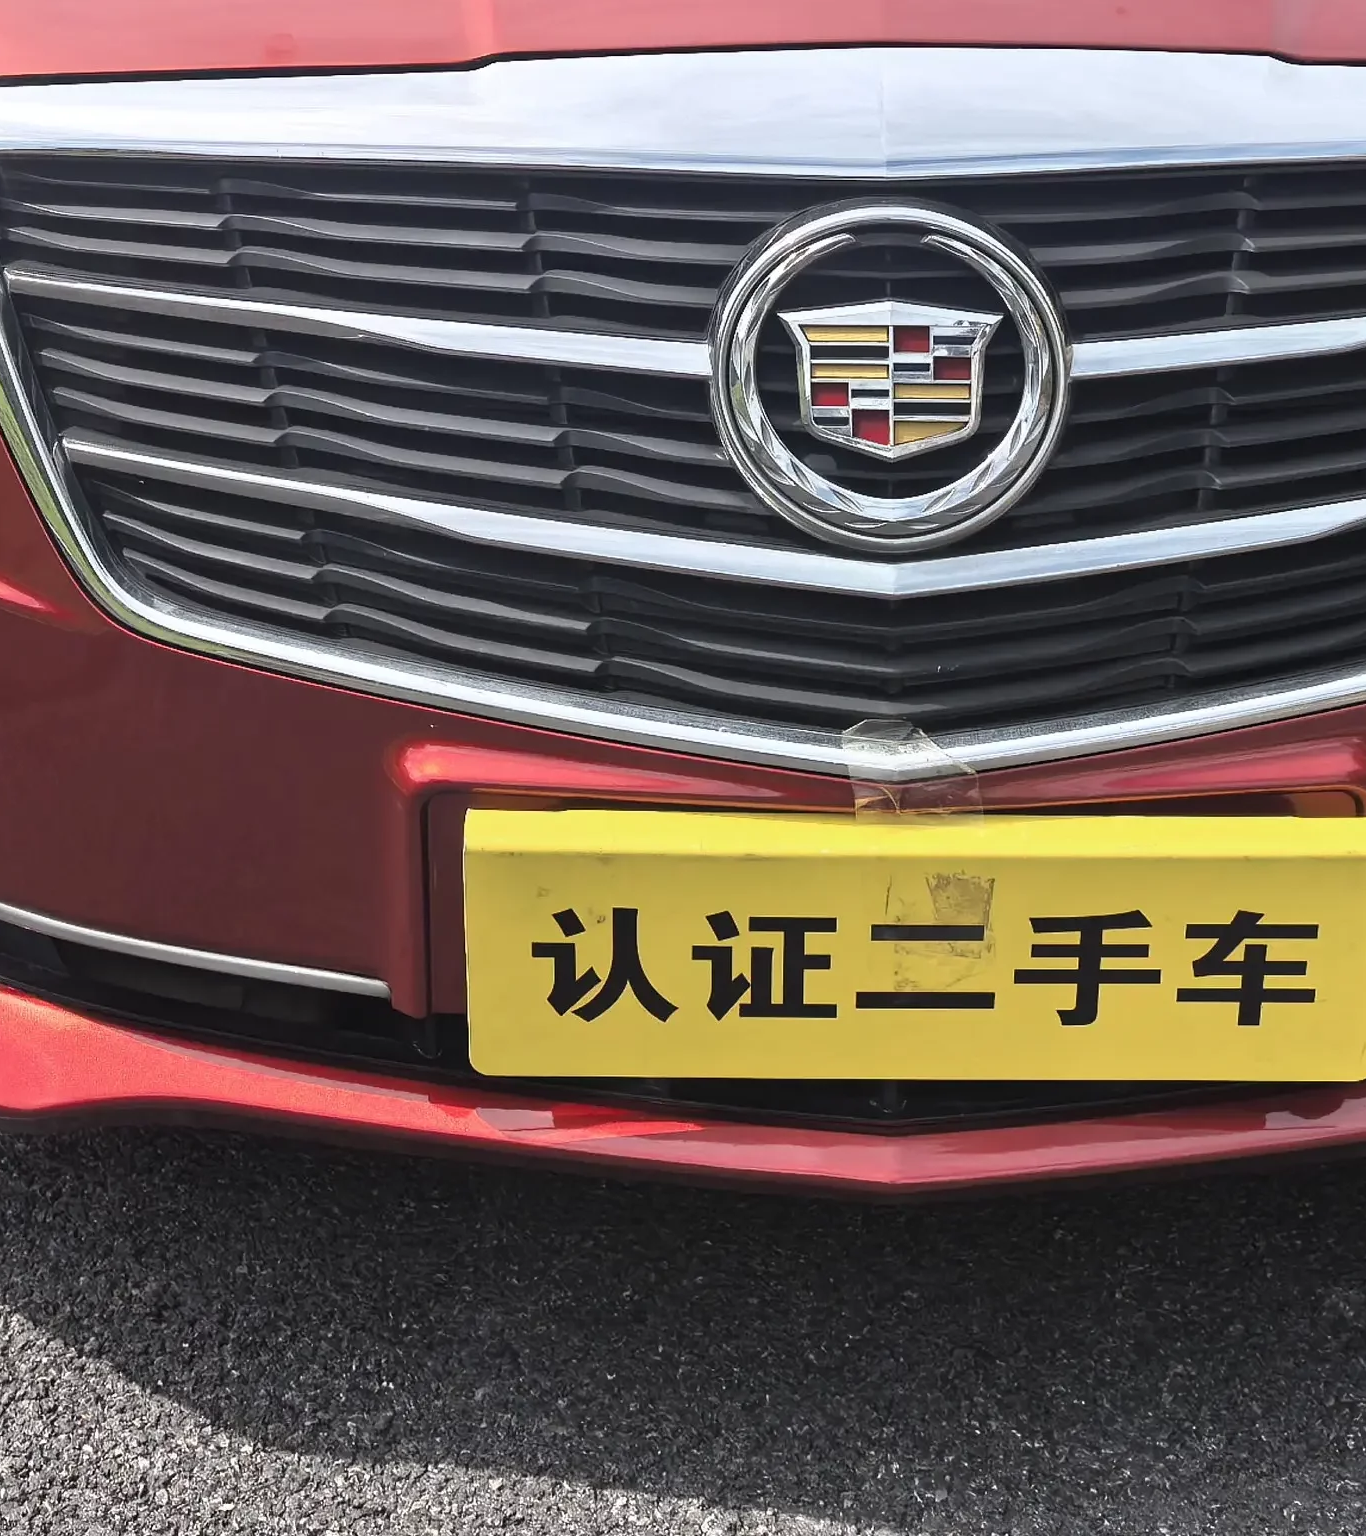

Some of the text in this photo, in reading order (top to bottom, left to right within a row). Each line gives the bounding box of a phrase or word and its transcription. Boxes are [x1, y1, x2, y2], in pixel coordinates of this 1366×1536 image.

[531, 907, 1320, 1026] 认证二手车
